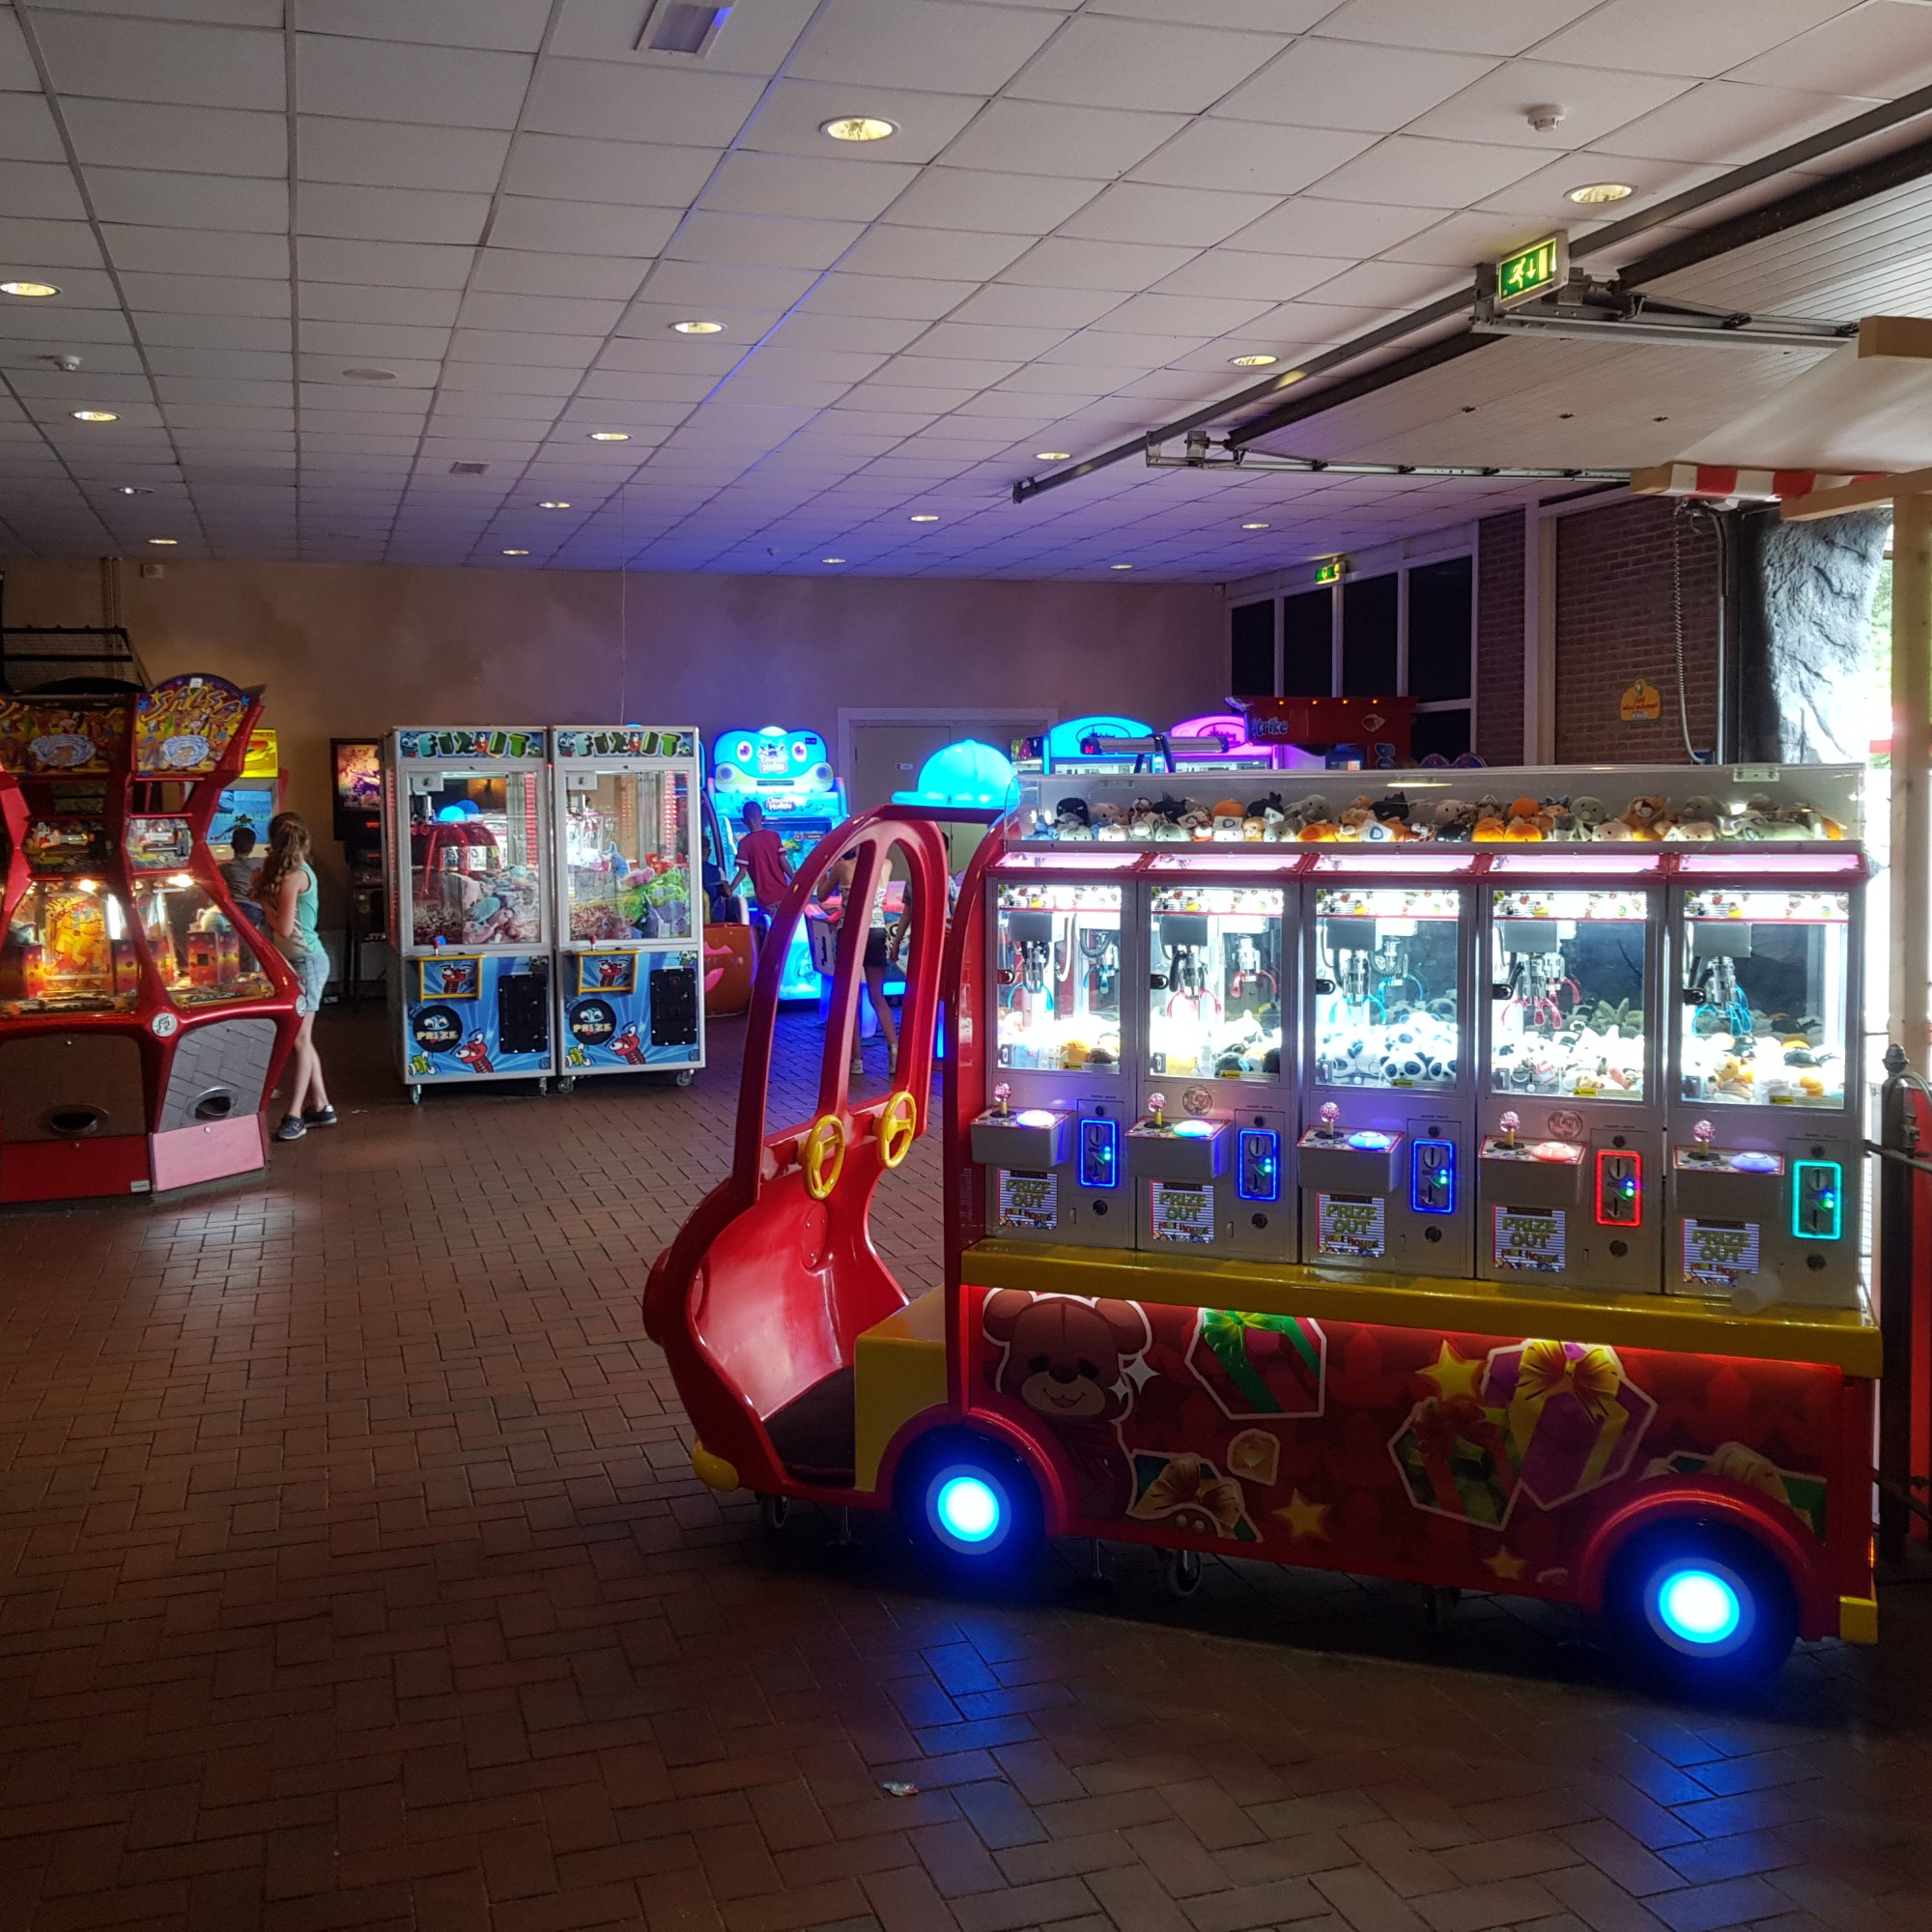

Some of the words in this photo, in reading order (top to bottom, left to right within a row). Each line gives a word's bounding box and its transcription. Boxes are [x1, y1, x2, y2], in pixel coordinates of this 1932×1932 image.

[416, 1030, 459, 1041] PRIZE
[573, 1023, 613, 1034] PRIZE
[1006, 1179, 1051, 1194] PRIZE
[1011, 1192, 1044, 1208] OUT
[1158, 1191, 1208, 1208] PRIZE
[1165, 1205, 1201, 1221] OUT
[1325, 1204, 1378, 1220] PRIZE
[1332, 1218, 1372, 1234] OUT
[1502, 1216, 1558, 1234] PRIZE
[1509, 1232, 1550, 1248] OUT
[1692, 1230, 1751, 1247] PRIZE
[1699, 1245, 1744, 1263] OUT
